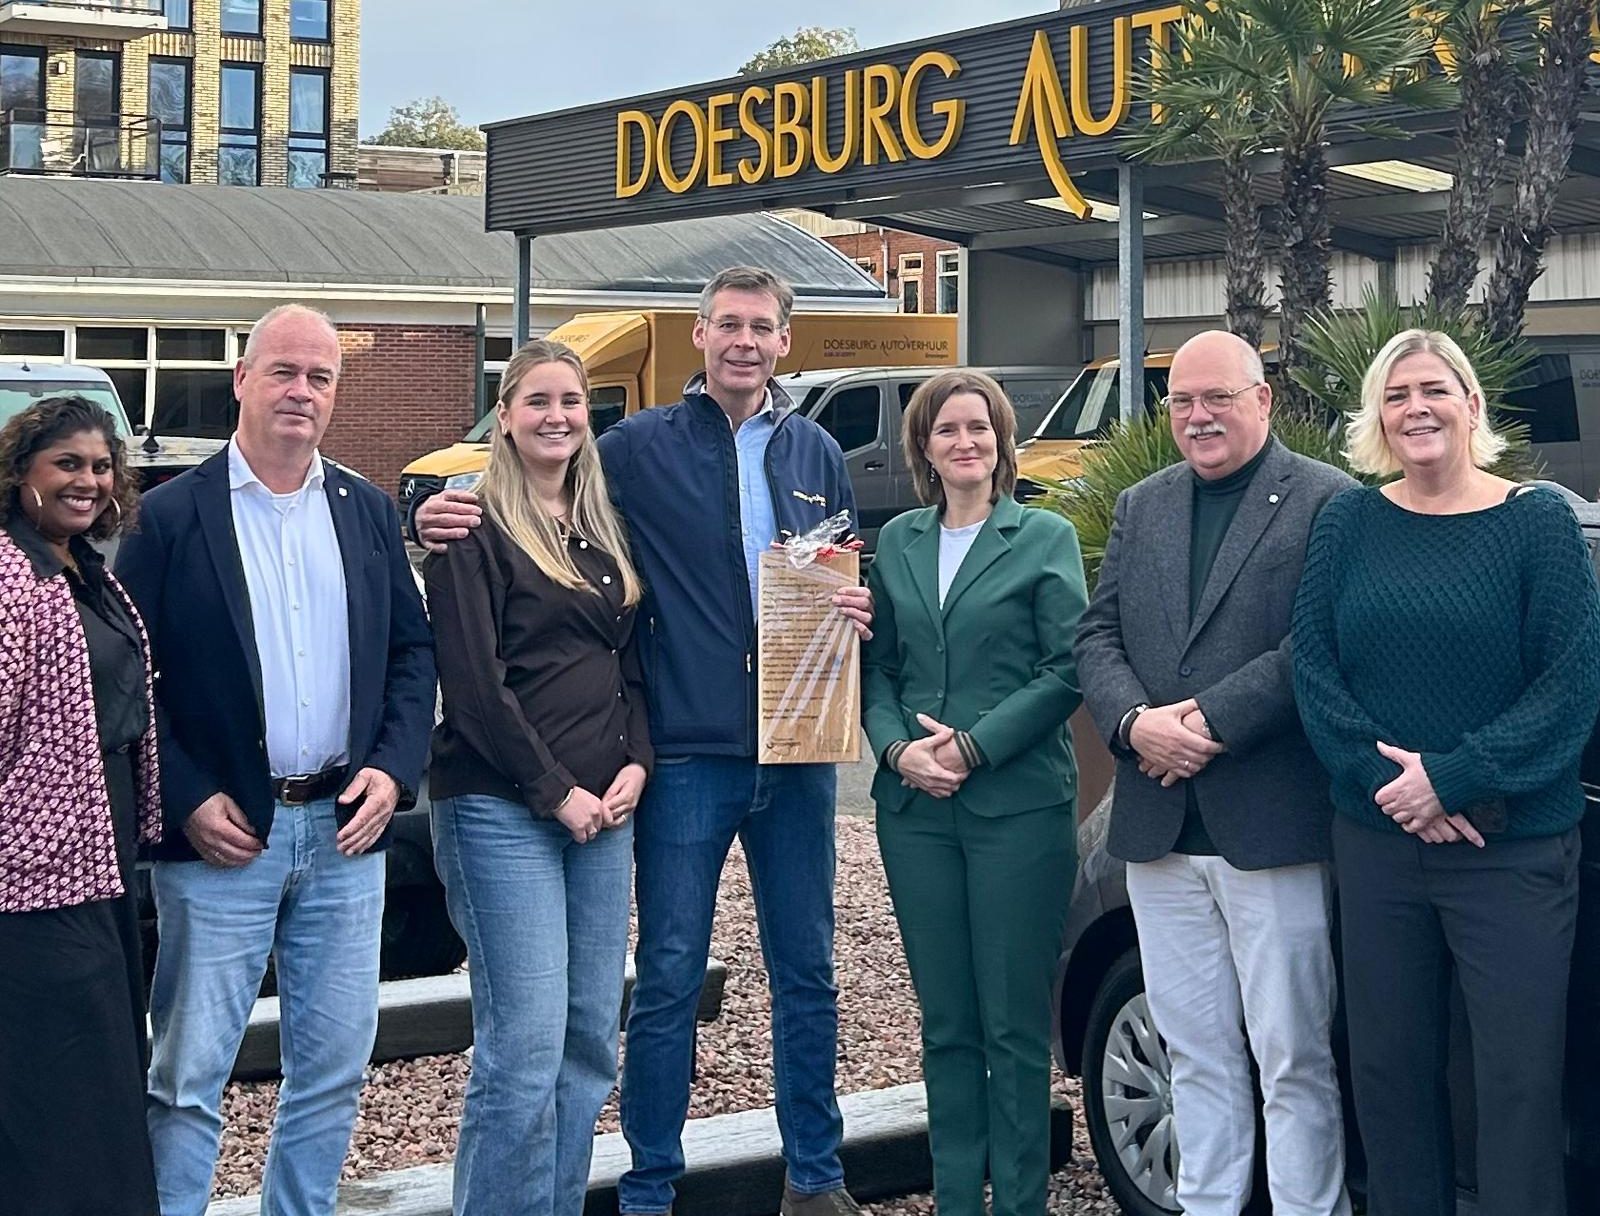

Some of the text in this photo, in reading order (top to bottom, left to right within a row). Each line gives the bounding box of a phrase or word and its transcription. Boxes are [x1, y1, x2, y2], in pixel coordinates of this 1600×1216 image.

[616, 51, 965, 199] DOESBURG
[823, 335, 949, 356] DOESBURG AUTOVERHUUR
